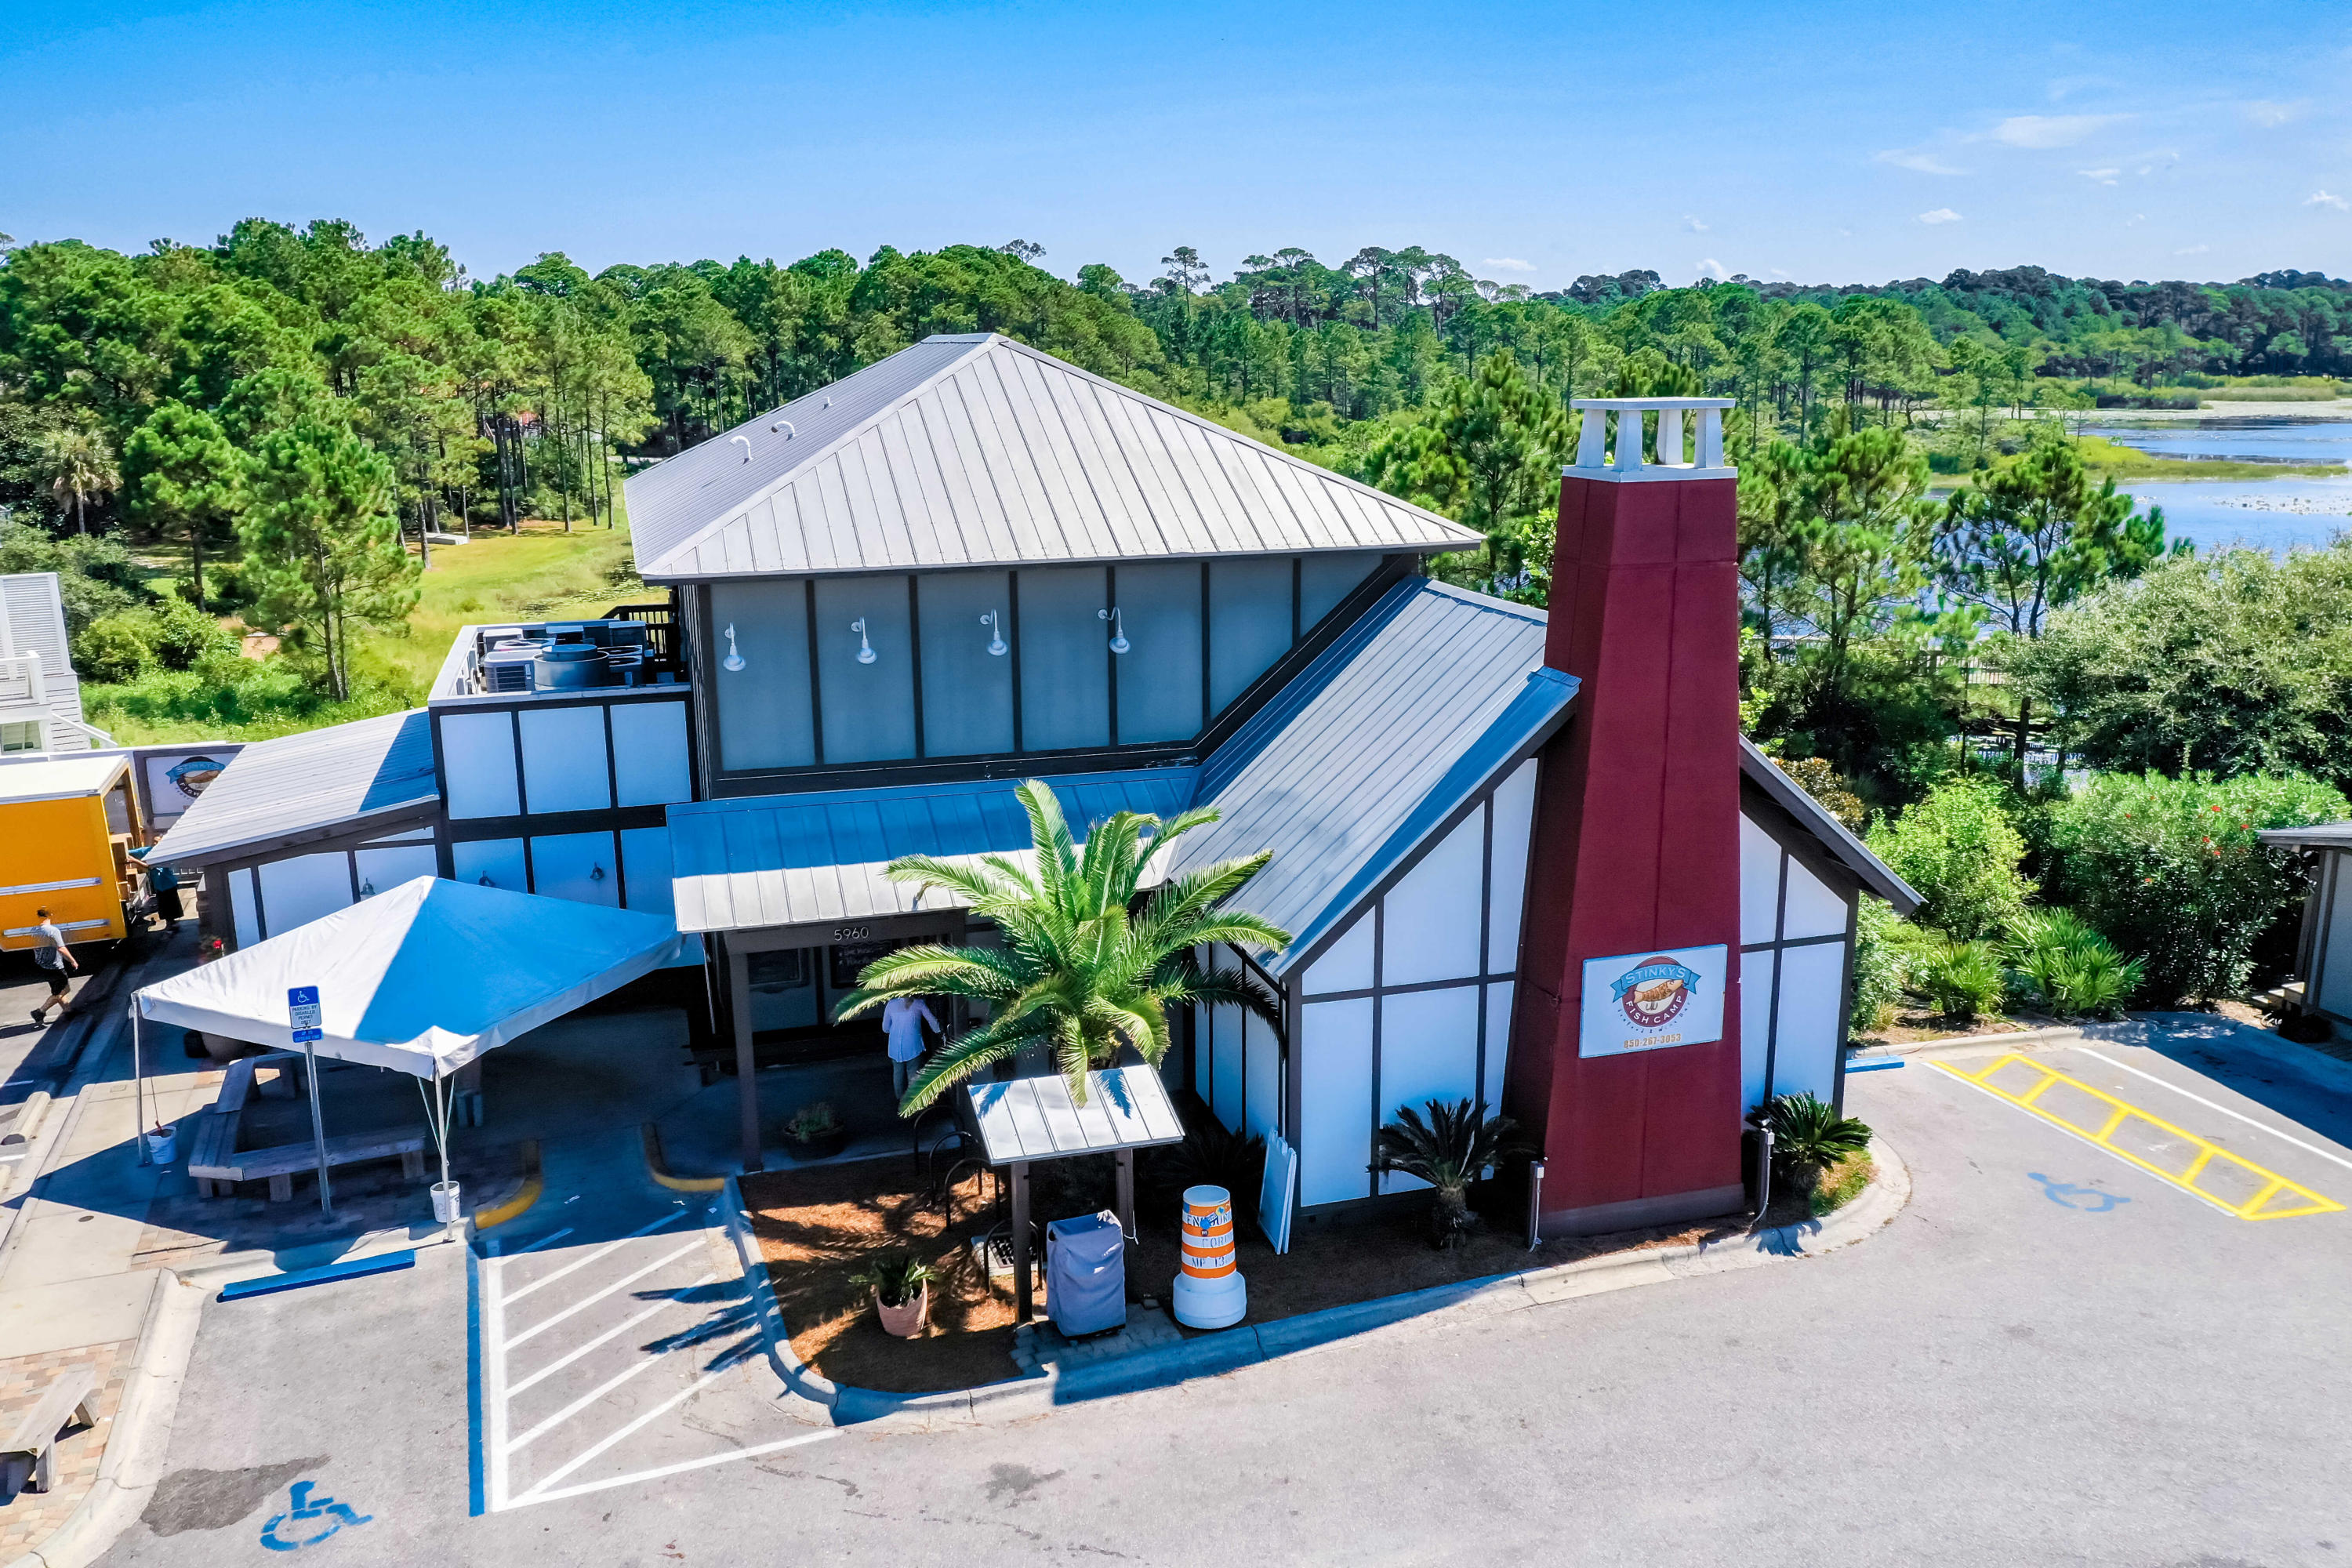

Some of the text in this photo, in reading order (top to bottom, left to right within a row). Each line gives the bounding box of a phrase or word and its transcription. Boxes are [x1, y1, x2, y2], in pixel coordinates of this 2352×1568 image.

[180, 782, 200, 797] FISH
[834, 927, 869, 942] 5960
[1625, 967, 1686, 984] STINKY'S
[1625, 995, 1682, 1024] FISH CAMP
[1624, 1033, 1682, 1049] 850-267-3053
